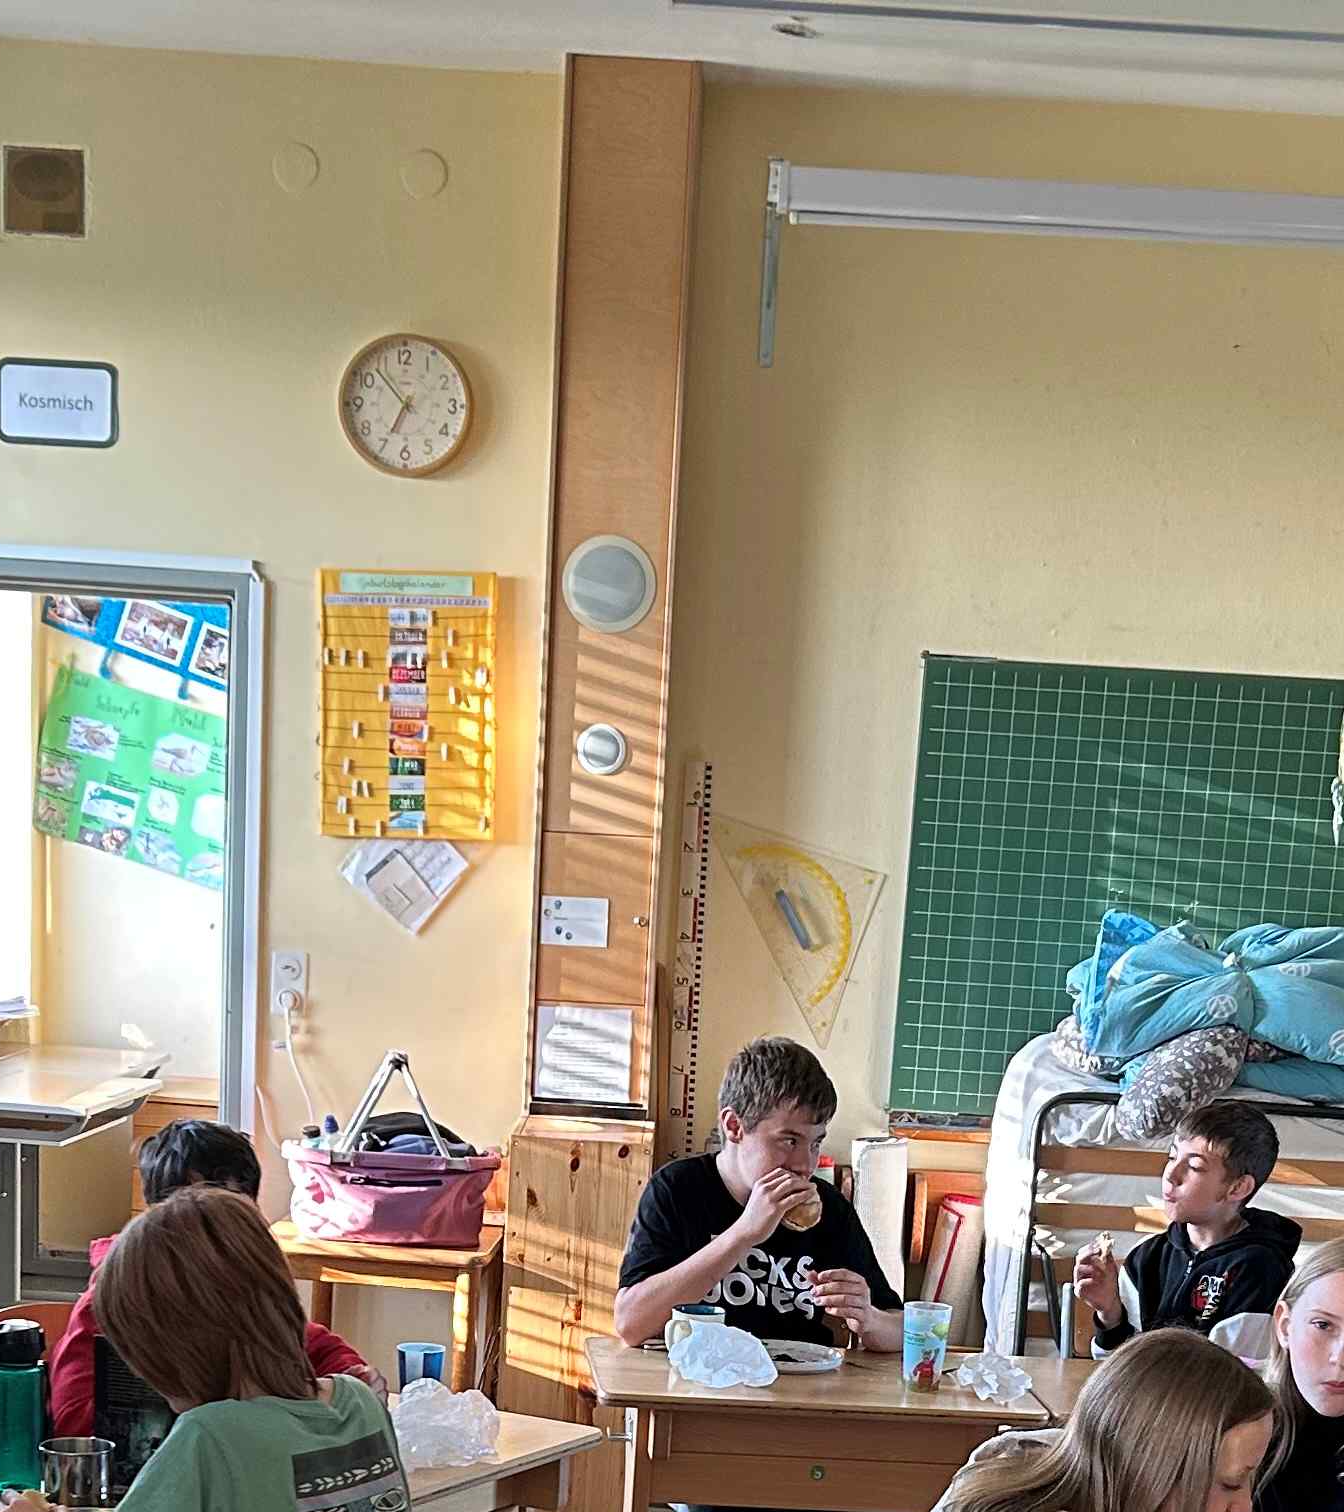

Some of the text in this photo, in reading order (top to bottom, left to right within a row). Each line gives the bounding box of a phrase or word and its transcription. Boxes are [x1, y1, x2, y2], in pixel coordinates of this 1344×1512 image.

[397, 349, 412, 366] 12
[358, 369, 375, 389] 10
[439, 374, 449, 390] 2
[18, 391, 94, 411] Kosmisch
[352, 396, 364, 412] 9
[447, 398, 457, 415] 3
[360, 419, 372, 437] 8
[438, 422, 449, 438] 4
[378, 438, 389, 454] 7
[399, 444, 411, 461] 6
[423, 438, 433, 455] 5
